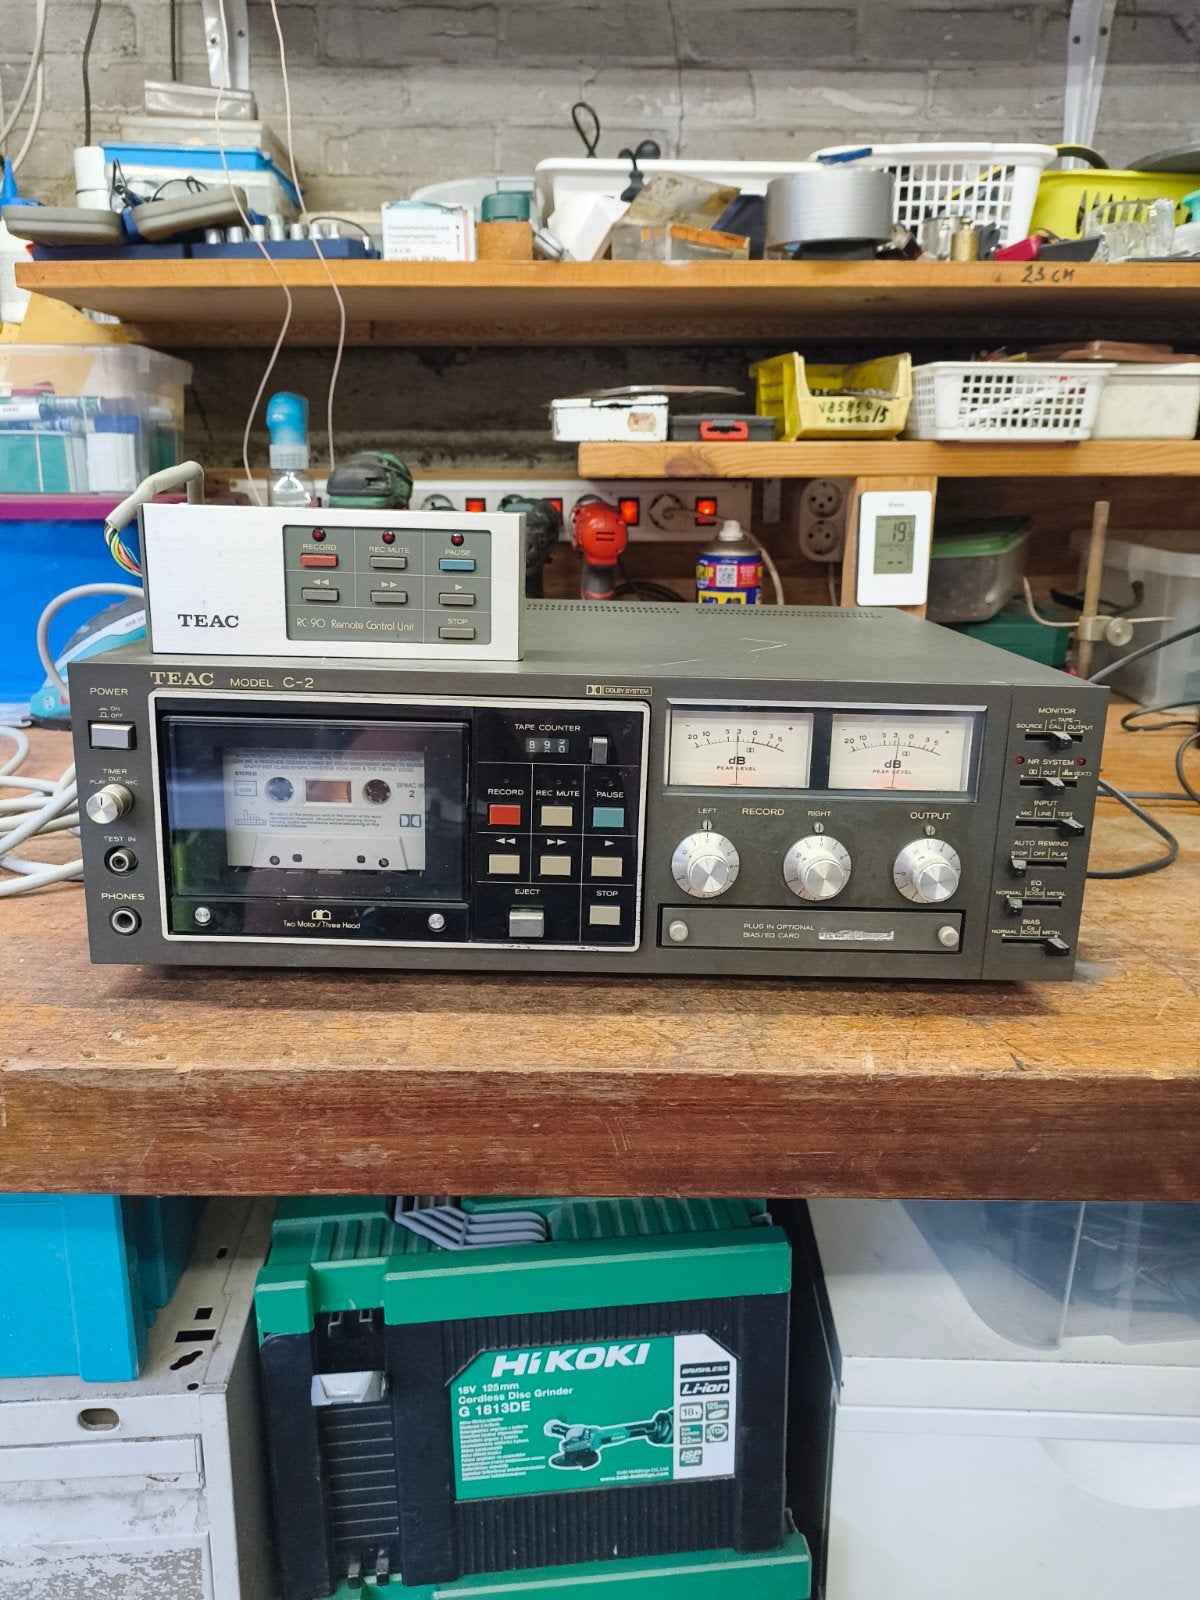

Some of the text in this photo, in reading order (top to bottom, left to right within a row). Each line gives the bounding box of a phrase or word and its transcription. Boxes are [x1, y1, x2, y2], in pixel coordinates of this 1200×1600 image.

[178, 614, 239, 628] TEAC
[296, 618, 414, 632] RC-90 Remote Control Unit
[150, 672, 314, 688] TEAC MODEL C-2
[90, 688, 128, 696] POWER
[538, 724, 582, 732] COUNTER
[728, 756, 746, 765] dB
[884, 760, 902, 769] dB
[488, 788, 524, 796] RECORD
[742, 808, 784, 816] RECORD
[910, 812, 951, 820] OUTPUT
[682, 1365, 728, 1374] BRUSHLESS
[458, 1383, 519, 1395] 18V 125mm
[682, 1382, 728, 1394] Li-ion
[458, 1387, 573, 1405] Cordless Disc Grinder
[458, 1401, 531, 1418] G 1813DE
